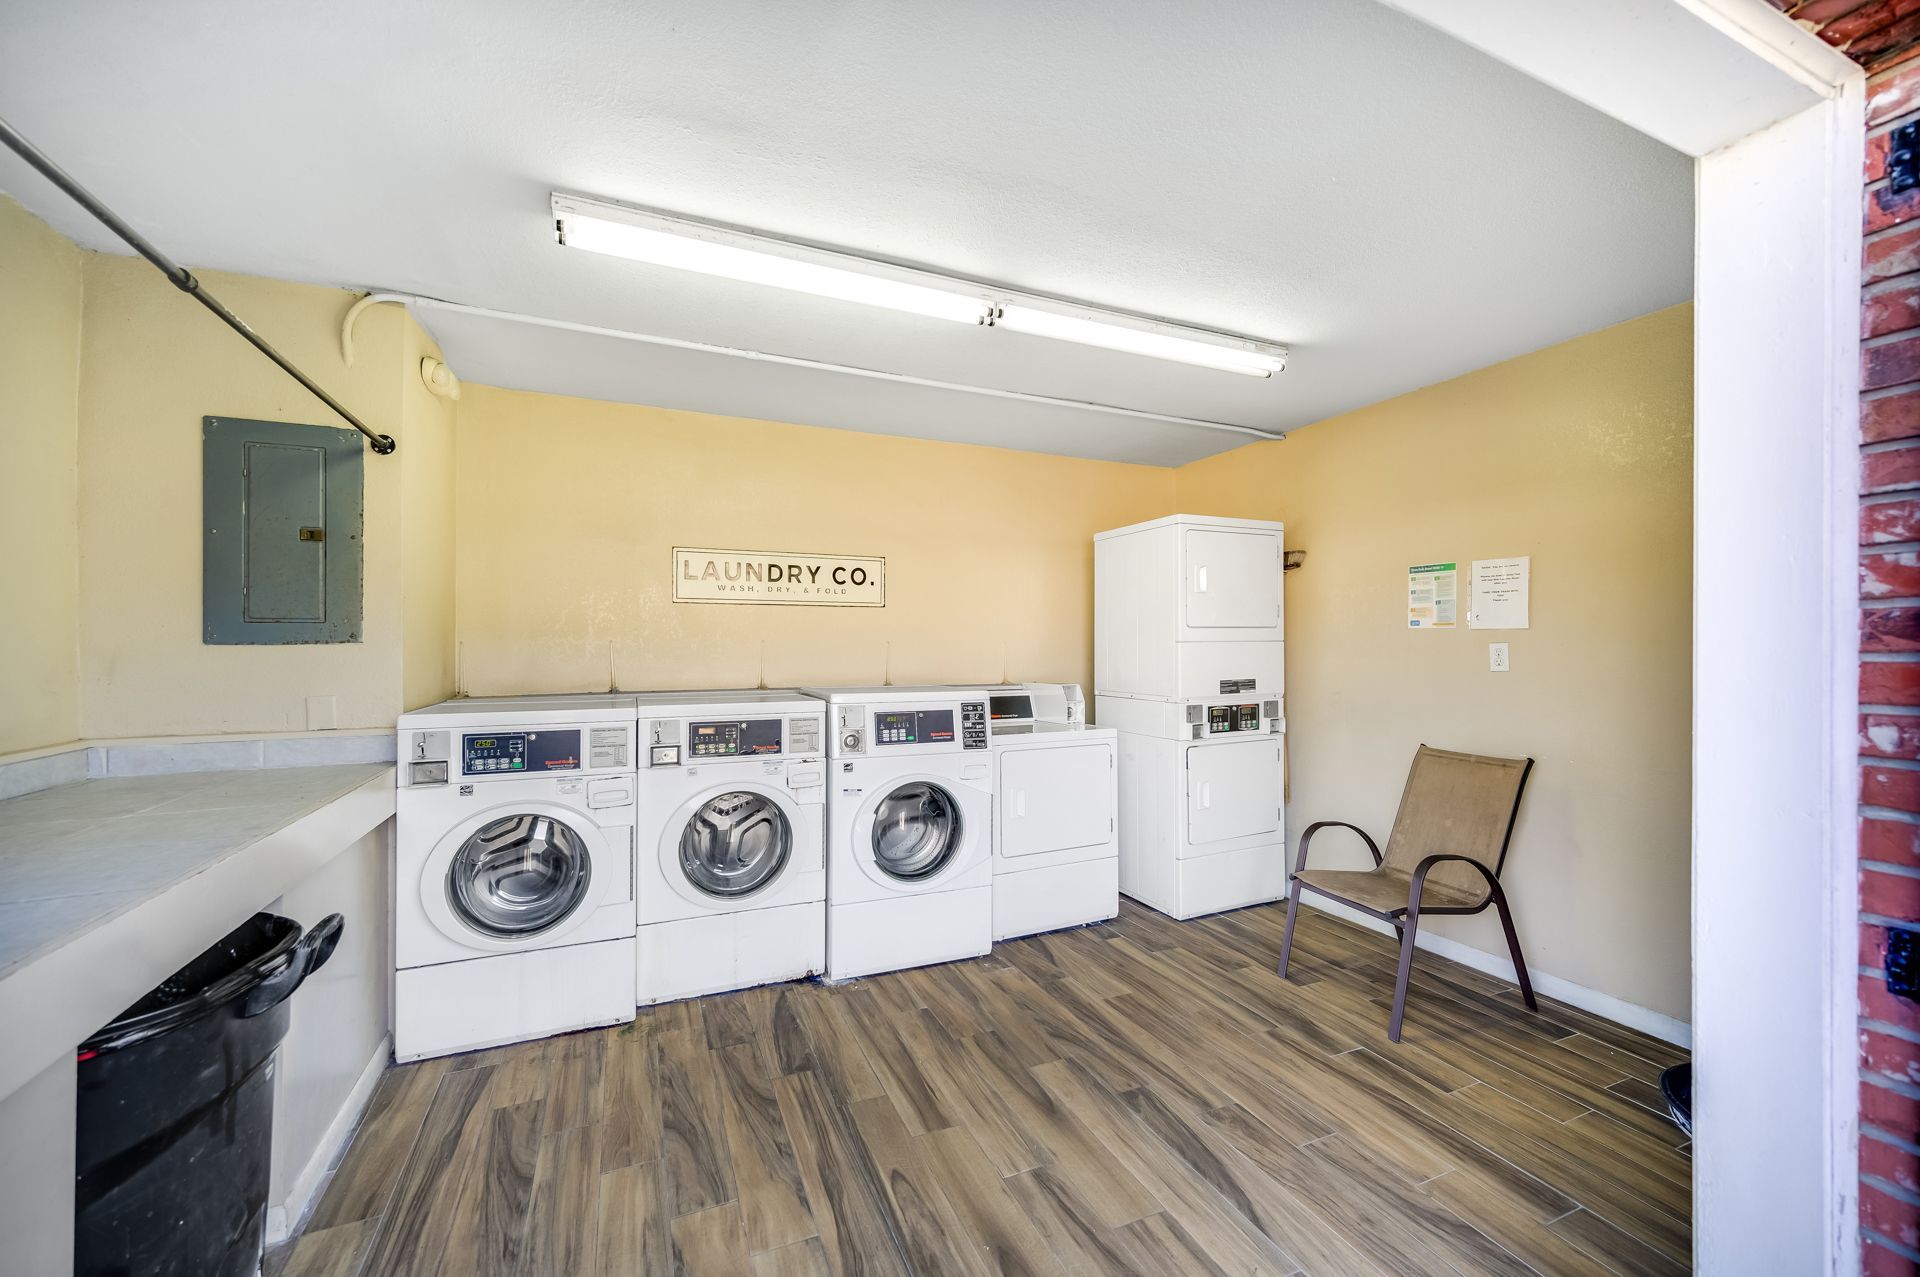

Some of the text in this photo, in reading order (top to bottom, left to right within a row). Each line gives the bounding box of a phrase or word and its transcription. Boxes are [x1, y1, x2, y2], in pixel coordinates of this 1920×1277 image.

[683, 560, 875, 587] LAUNDRY CO.
[717, 584, 760, 593] WASH,
[816, 587, 848, 595] FOLD
